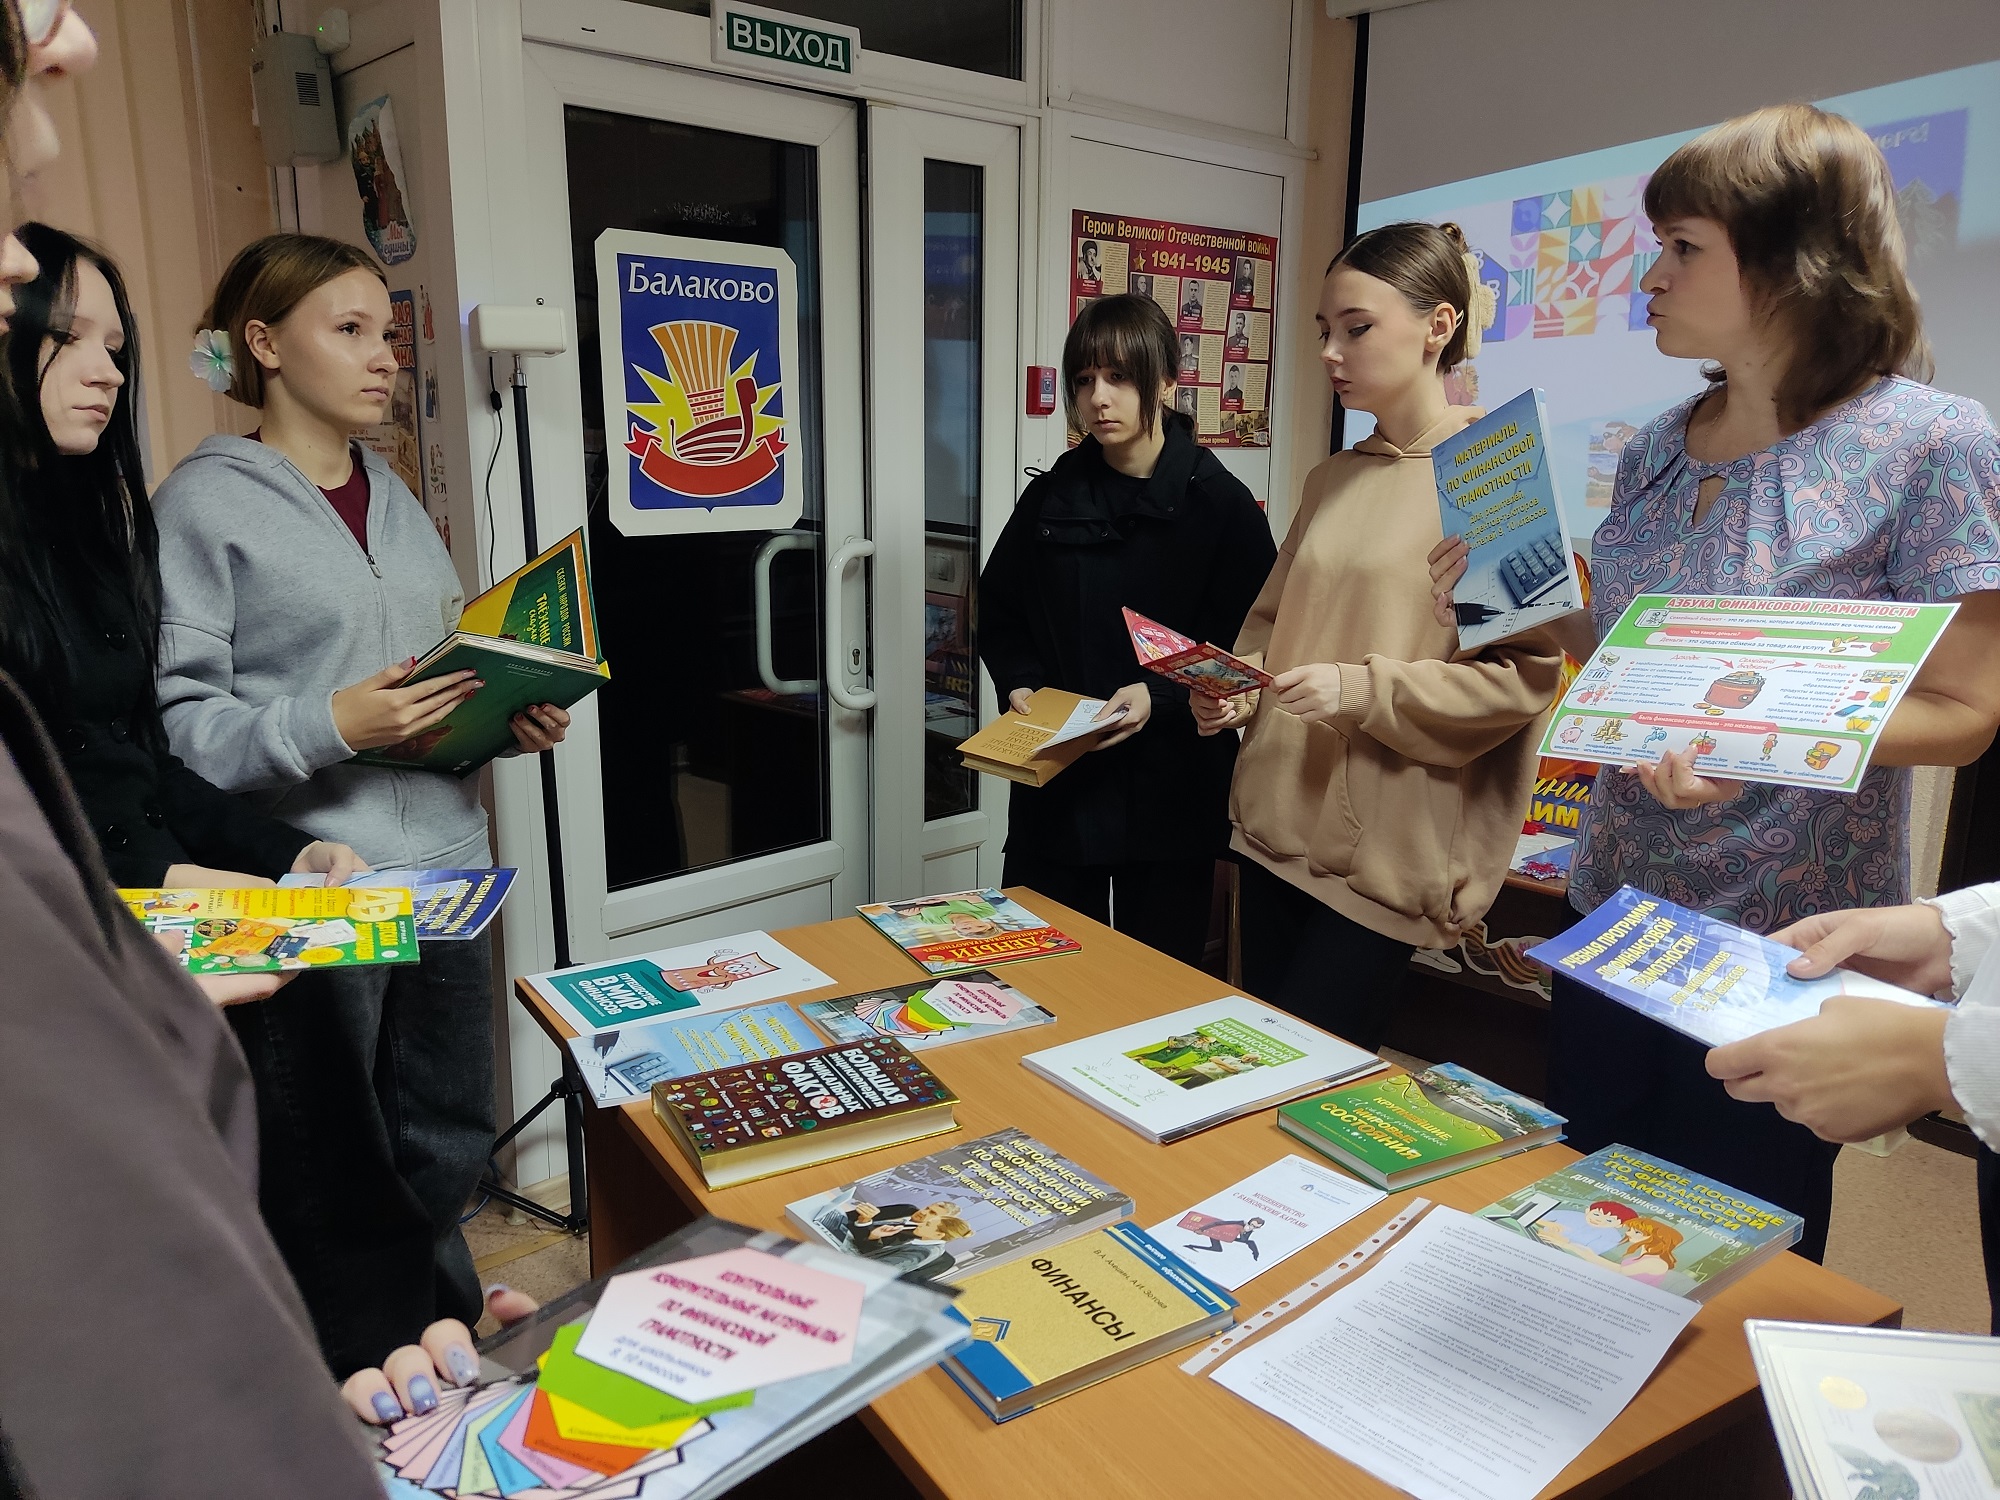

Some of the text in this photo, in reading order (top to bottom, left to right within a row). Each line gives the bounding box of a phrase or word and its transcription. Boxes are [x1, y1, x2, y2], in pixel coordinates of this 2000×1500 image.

[732, 17, 845, 70] ВЫХОД
[387, 221, 403, 241] Мы
[1082, 215, 1271, 255] Герои Великой Отечественной войны
[384, 242, 409, 262] едины
[628, 262, 774, 304] Балаково
[1446, 431, 1536, 494] ПО ФИНАНСОВОЙ
[1455, 421, 1518, 467] МАТЕРИАЛЫ
[1455, 461, 1532, 510] ГРАМОТНОСТИ
[1470, 512, 1482, 526] для
[524, 609, 537, 642] сказки
[536, 593, 552, 645] ТАЁЖНЫЕ
[556, 567, 572, 647] СКАЗКИ НАРОДОВ РОССИИ
[1666, 598, 1919, 618] АЗБУКА ФИНАНСОВОЙ ГРАМОТНОСТИ
[1796, 620, 1840, 628] зарабатывают
[1006, 736, 1035, 746] ЗНАКИ
[1009, 730, 1044, 743] РОССИИ
[1638, 714, 1652, 722] Быть
[1653, 716, 1685, 725] финансово
[1685, 718, 1719, 727] грамотным
[1734, 723, 1768, 732] несложно:
[981, 743, 1032, 760] БУМАЖНЫЕ
[425, 882, 473, 930] ПО ФИНАНСОВОЙ
[442, 874, 497, 934] УЧЕБНАЯ ПРОГРАММА
[376, 922, 399, 946] ДЕТСКАЯ
[399, 920, 407, 944] ЖУРНАЛ
[922, 939, 984, 953] ГРАМОТНОСТЬ
[949, 936, 1039, 959] ДЕНЬГИ
[984, 931, 1040, 943] ФИНАНСОВАЯ
[1558, 900, 1660, 970] УЧЕБНАЯ ПРОГРАММА
[1595, 916, 1678, 979] ПО ФИНАНСОВОЙ
[592, 975, 618, 987] В
[1628, 934, 1699, 989] ГРАМОТНОСТИ
[578, 980, 622, 1015] ФИНАНСОВ
[601, 983, 647, 1010] МИР
[618, 972, 662, 1007] ПУТЕШЕСТВИЕ
[1691, 1000, 1709, 1012] 9,
[1702, 991, 1721, 1005] 10
[738, 1014, 754, 1024] ПО
[1277, 1023, 1312, 1042] Банк России
[1202, 1025, 1282, 1065] ГРАМОТНОСТИ
[1213, 1022, 1294, 1061] ФИНАНСОВОЙ
[781, 1061, 845, 1119] ФАКТОВ
[805, 1057, 865, 1113] УНИКАЛЬНЫХ
[828, 1052, 887, 1108] энциклопедия
[841, 1048, 910, 1105] БОЛЬШАЯ
[718, 1090, 734, 1109] Реклама
[732, 1109, 743, 1120] Суд
[744, 1069, 795, 1129] Мода Еда Деньги Семья
[1373, 1097, 1452, 1141] КРУПНЕЙШИЕ
[1321, 1102, 1422, 1161] СОСТОЯНИЯ
[1353, 1108, 1418, 1144] МИРОВЫЕ
[961, 1159, 1052, 1217] ГРАМОТНОСТИ
[971, 1149, 1081, 1216] ПО ФИНАНСОВОЙ
[991, 1144, 1093, 1208] РЕКОМЕНДАЦИИ
[1008, 1139, 1108, 1200] МЕТОДИЧЕСКИЕ
[1608, 1151, 1787, 1227] УЧЕБНОЕ ПОСОБИЕ
[939, 1164, 1036, 1227] для учителя 9, 10 классов
[1239, 1194, 1281, 1219] БАНКОВСКИМИ
[1279, 1211, 1309, 1229] КАРТАМИ
[1252, 1191, 1306, 1218] МОШЕННИЧЕСТВО
[1569, 1173, 1743, 1248] ДЛЯ ШКОЛЬНИКОВ 9, 10 КЛАССОВ
[1604, 1160, 1768, 1231] ПО ФИНАНСОВОЙ
[1604, 1171, 1742, 1231] ГРАМОТНОСТИ
[1144, 1243, 1167, 1260] высшее
[718, 1270, 819, 1310] КОНТРОЛЬНЫЕ
[1144, 1288, 1168, 1309] Зотова
[1161, 1265, 1197, 1294] образование
[1031, 1257, 1136, 1343] ФИНАНСЫ
[639, 1318, 739, 1362] ГРАМОТНОСТИ
[658, 1299, 777, 1346] ПО ФИНАНСОВОЙ
